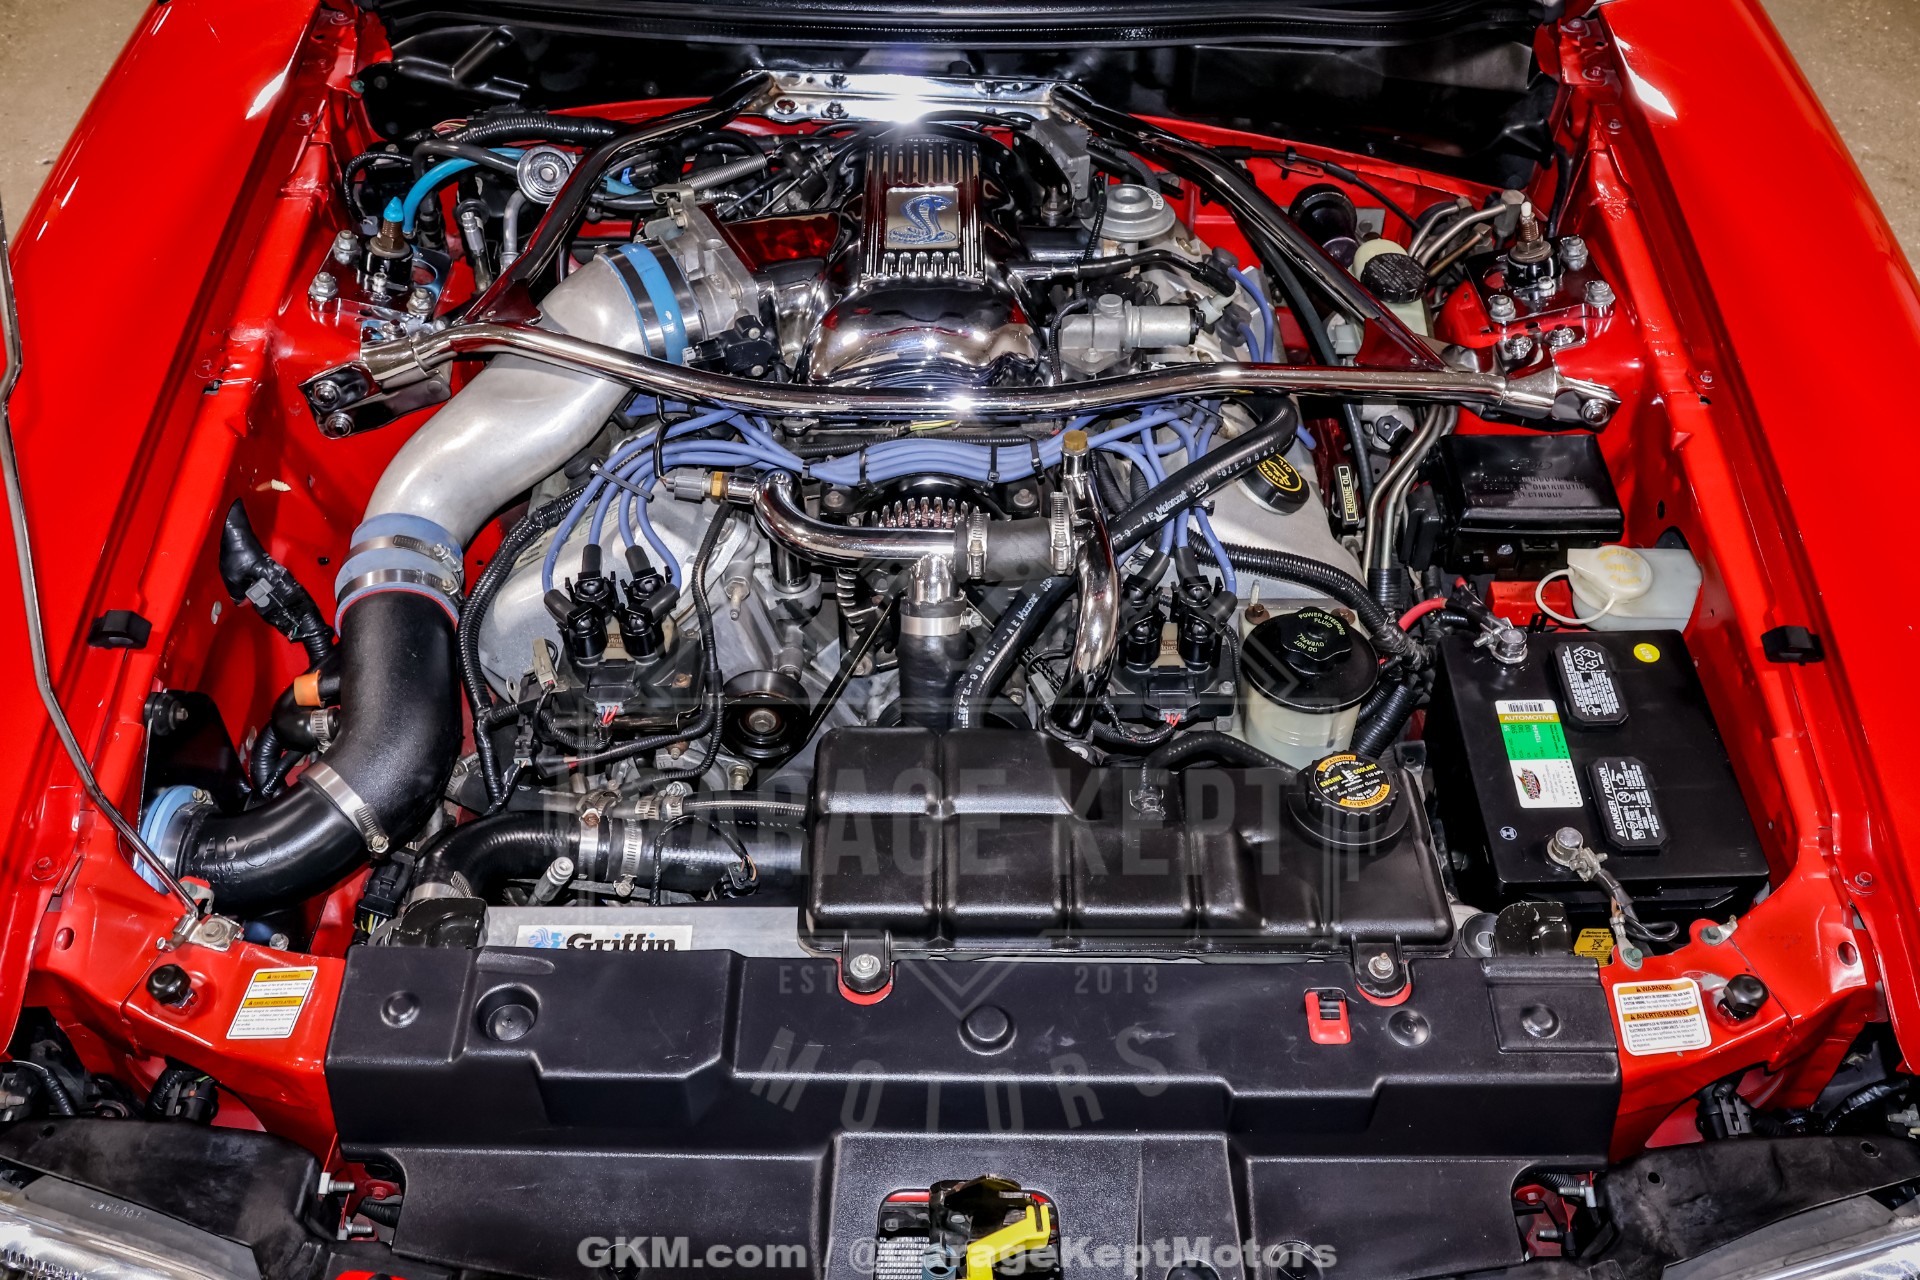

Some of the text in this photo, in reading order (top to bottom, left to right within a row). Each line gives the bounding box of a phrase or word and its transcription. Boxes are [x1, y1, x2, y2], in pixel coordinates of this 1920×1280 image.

[1279, 459, 1292, 473] OIL
[1344, 484, 1357, 513] ENGINE
[1298, 612, 1346, 636] POWER STEERING
[1314, 618, 1333, 628] FLUID
[1293, 640, 1307, 650] NOT
[1320, 763, 1377, 787] ENGINE COOLANT
[1598, 768, 1612, 794] POISON
[1348, 784, 1364, 792] Owner
[1608, 800, 1623, 830] DANGER
[567, 932, 677, 951] Griffin
[1642, 984, 1672, 992] WARNING
[1636, 1010, 1690, 1020] AVERTISSEMENT
